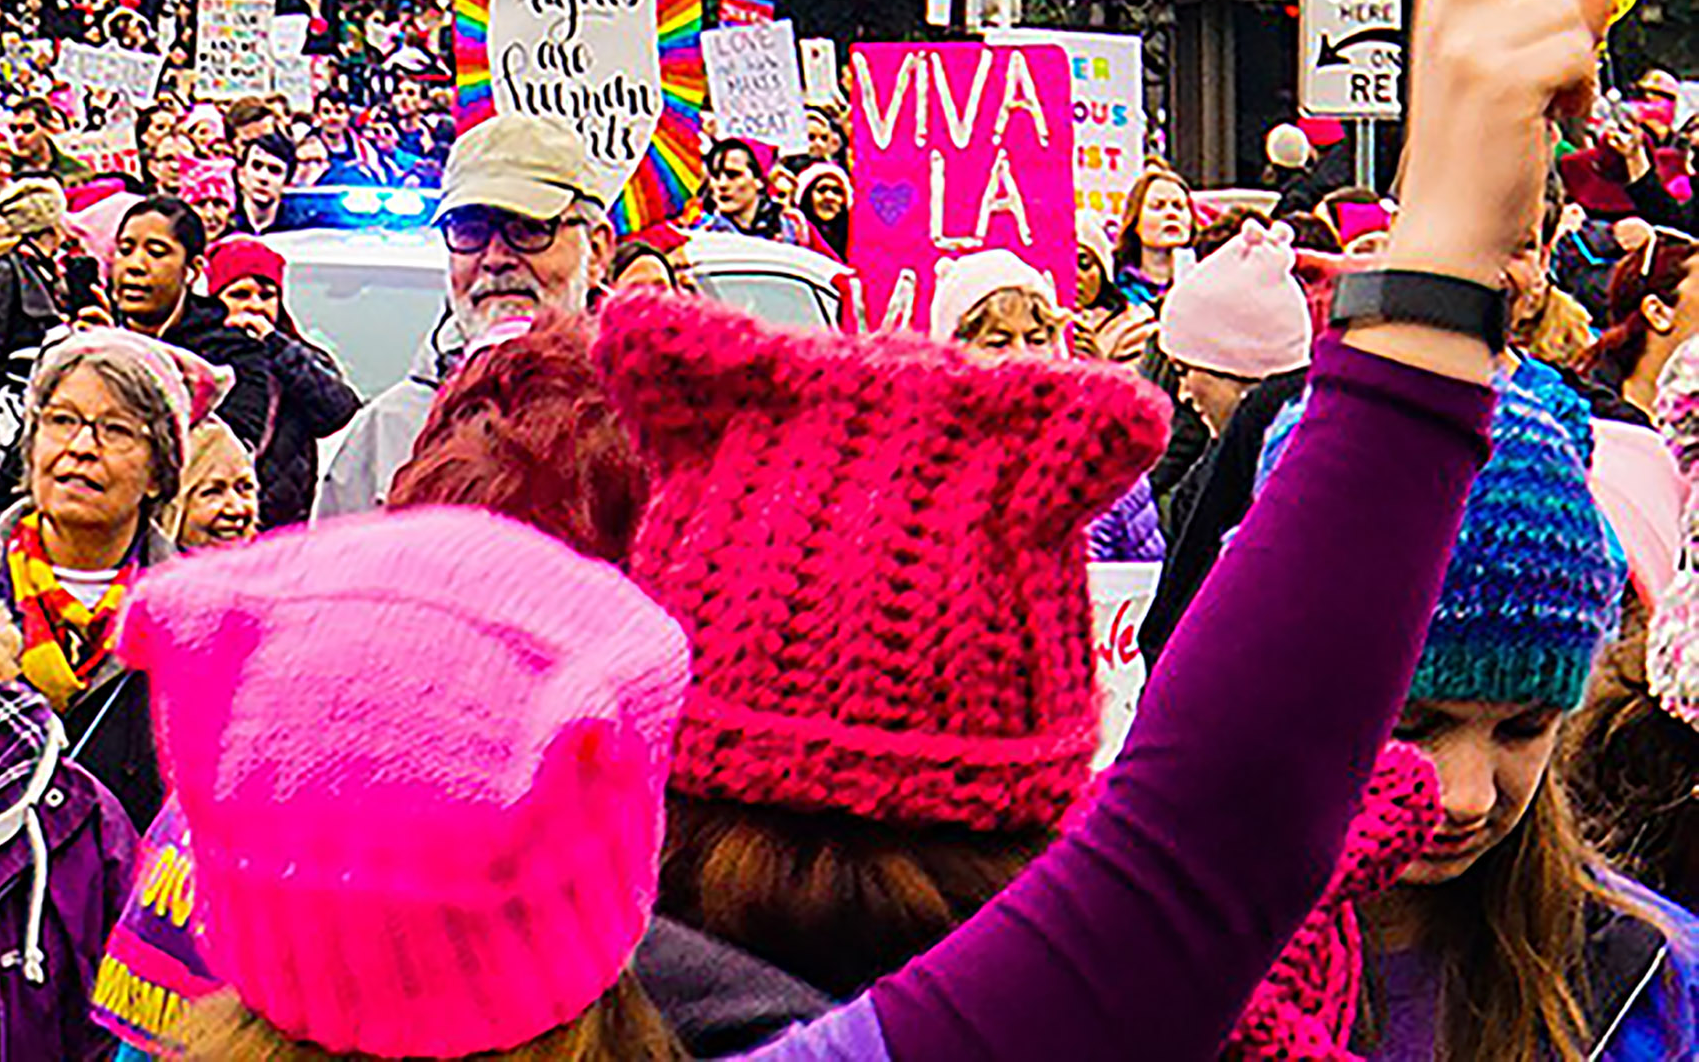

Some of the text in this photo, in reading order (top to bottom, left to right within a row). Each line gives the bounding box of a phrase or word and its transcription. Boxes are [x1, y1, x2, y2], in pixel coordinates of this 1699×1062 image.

[1072, 56, 1111, 81] ER
[852, 48, 1050, 150] VIVA
[1351, 74, 1392, 103] RE
[1072, 101, 1128, 127] OUS
[1078, 145, 1122, 171] IST
[930, 148, 1034, 247] LA
